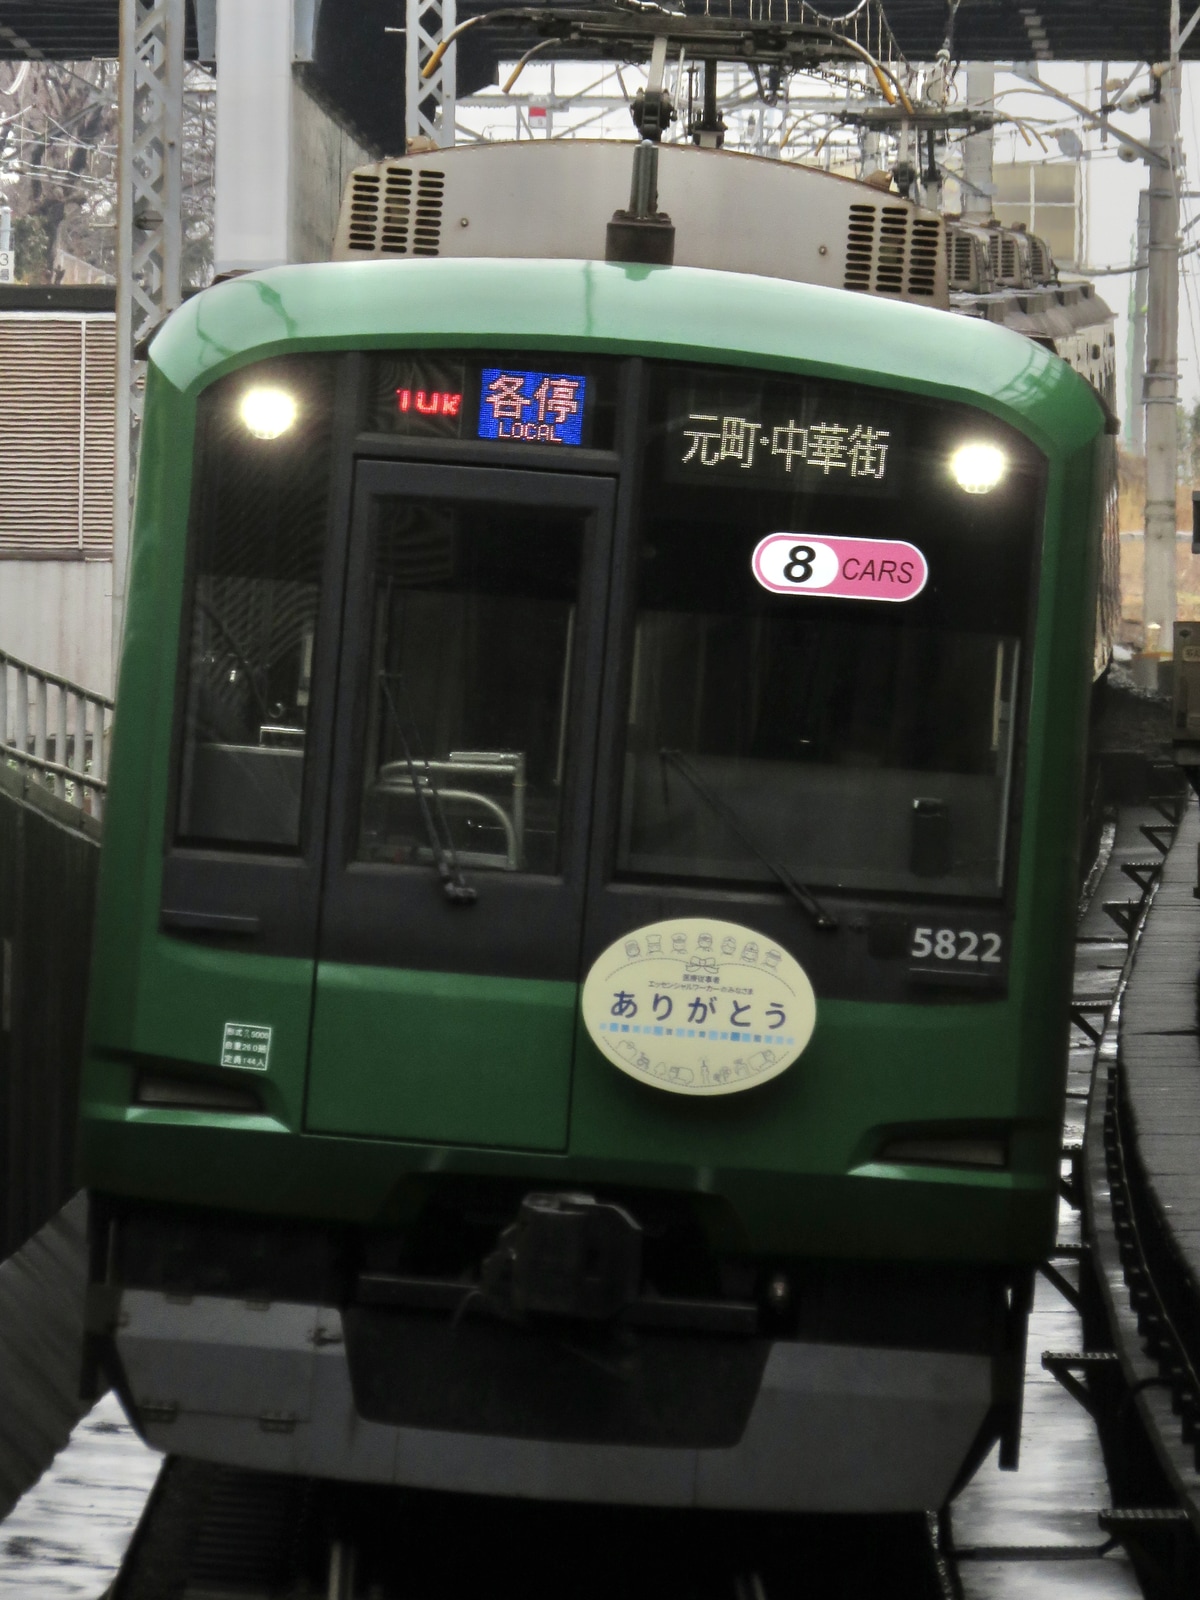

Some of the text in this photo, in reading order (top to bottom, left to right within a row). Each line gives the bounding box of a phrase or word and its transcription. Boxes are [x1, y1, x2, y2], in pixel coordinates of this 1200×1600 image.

[485, 374, 580, 423] 各停
[498, 421, 562, 442] LOCAL
[783, 545, 914, 584] 8 CARS
[911, 927, 1002, 963] 5822
[610, 990, 787, 1030] ありがとう
